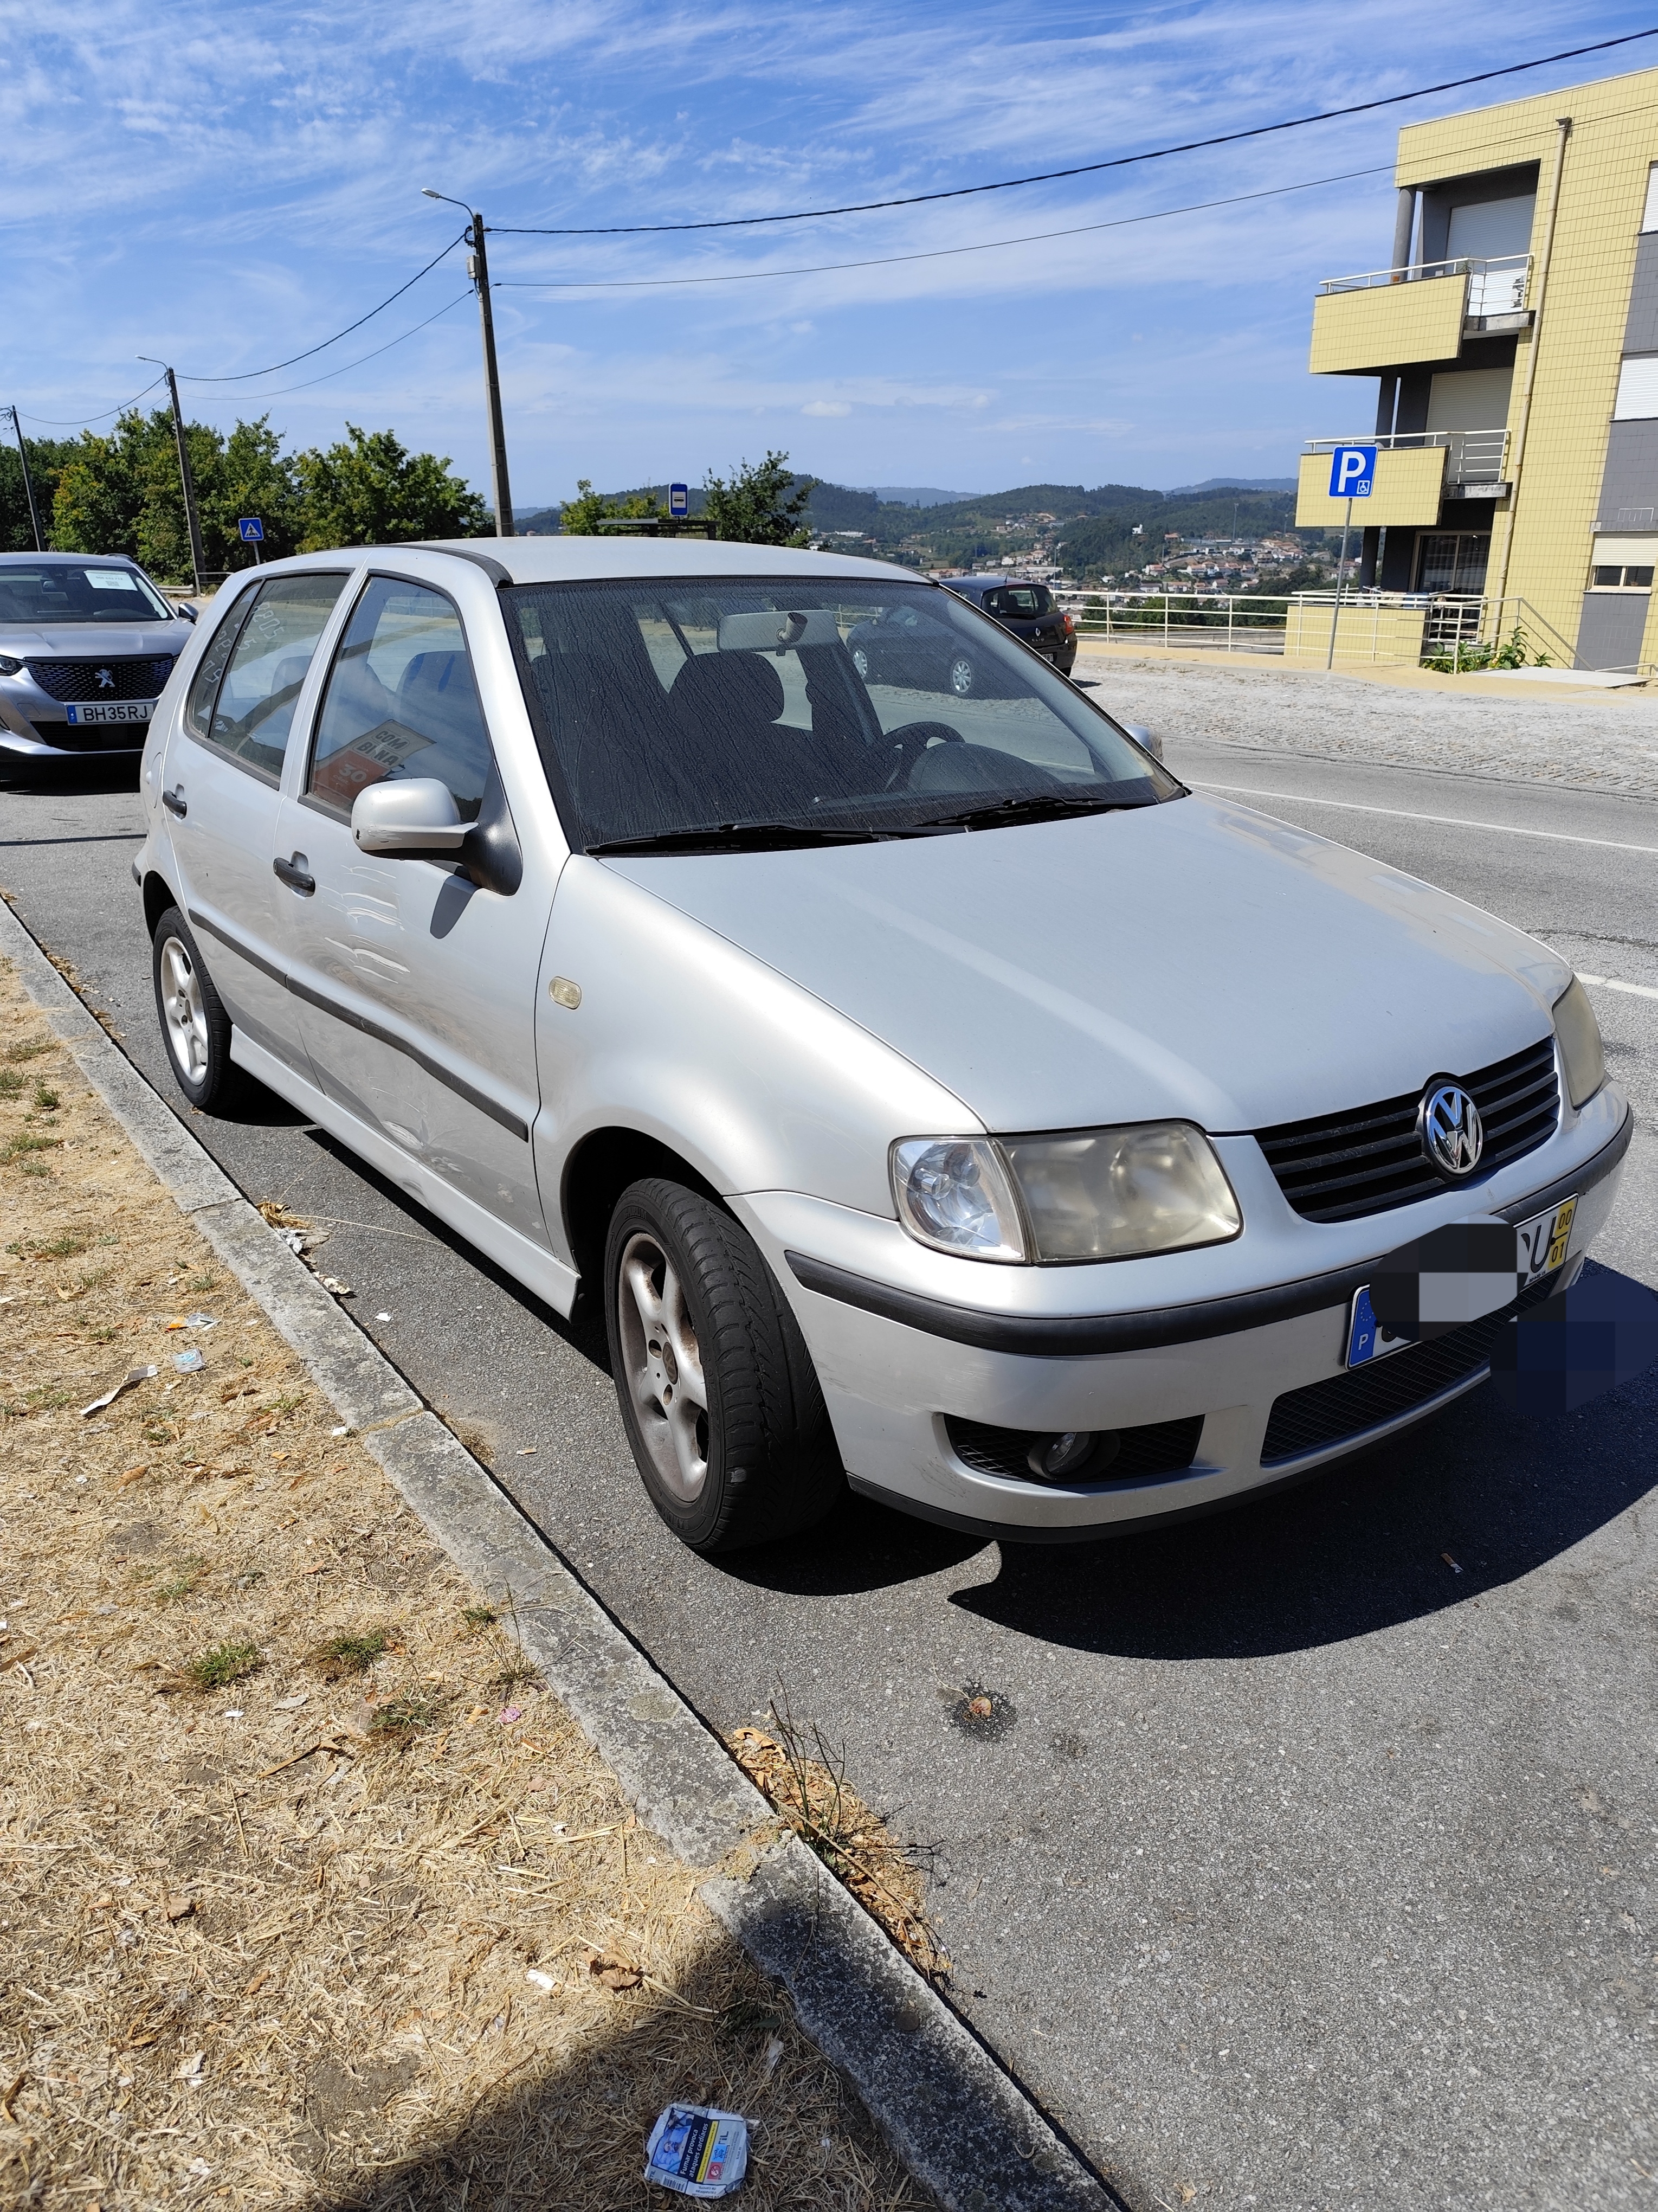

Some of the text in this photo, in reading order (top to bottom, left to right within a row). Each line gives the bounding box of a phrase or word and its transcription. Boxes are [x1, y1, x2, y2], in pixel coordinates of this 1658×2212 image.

[1338, 451, 1366, 493] P
[375, 731, 408, 749] COM
[339, 763, 367, 782] 30
[1558, 1209, 1572, 1230] 00
[1552, 1242, 1565, 1263] 01
[1358, 1333, 1369, 1351] P
[680, 2129, 699, 2175] Fumar provoca
[689, 2152, 700, 2177] ataques
[697, 2123, 708, 2151] cardíacos
